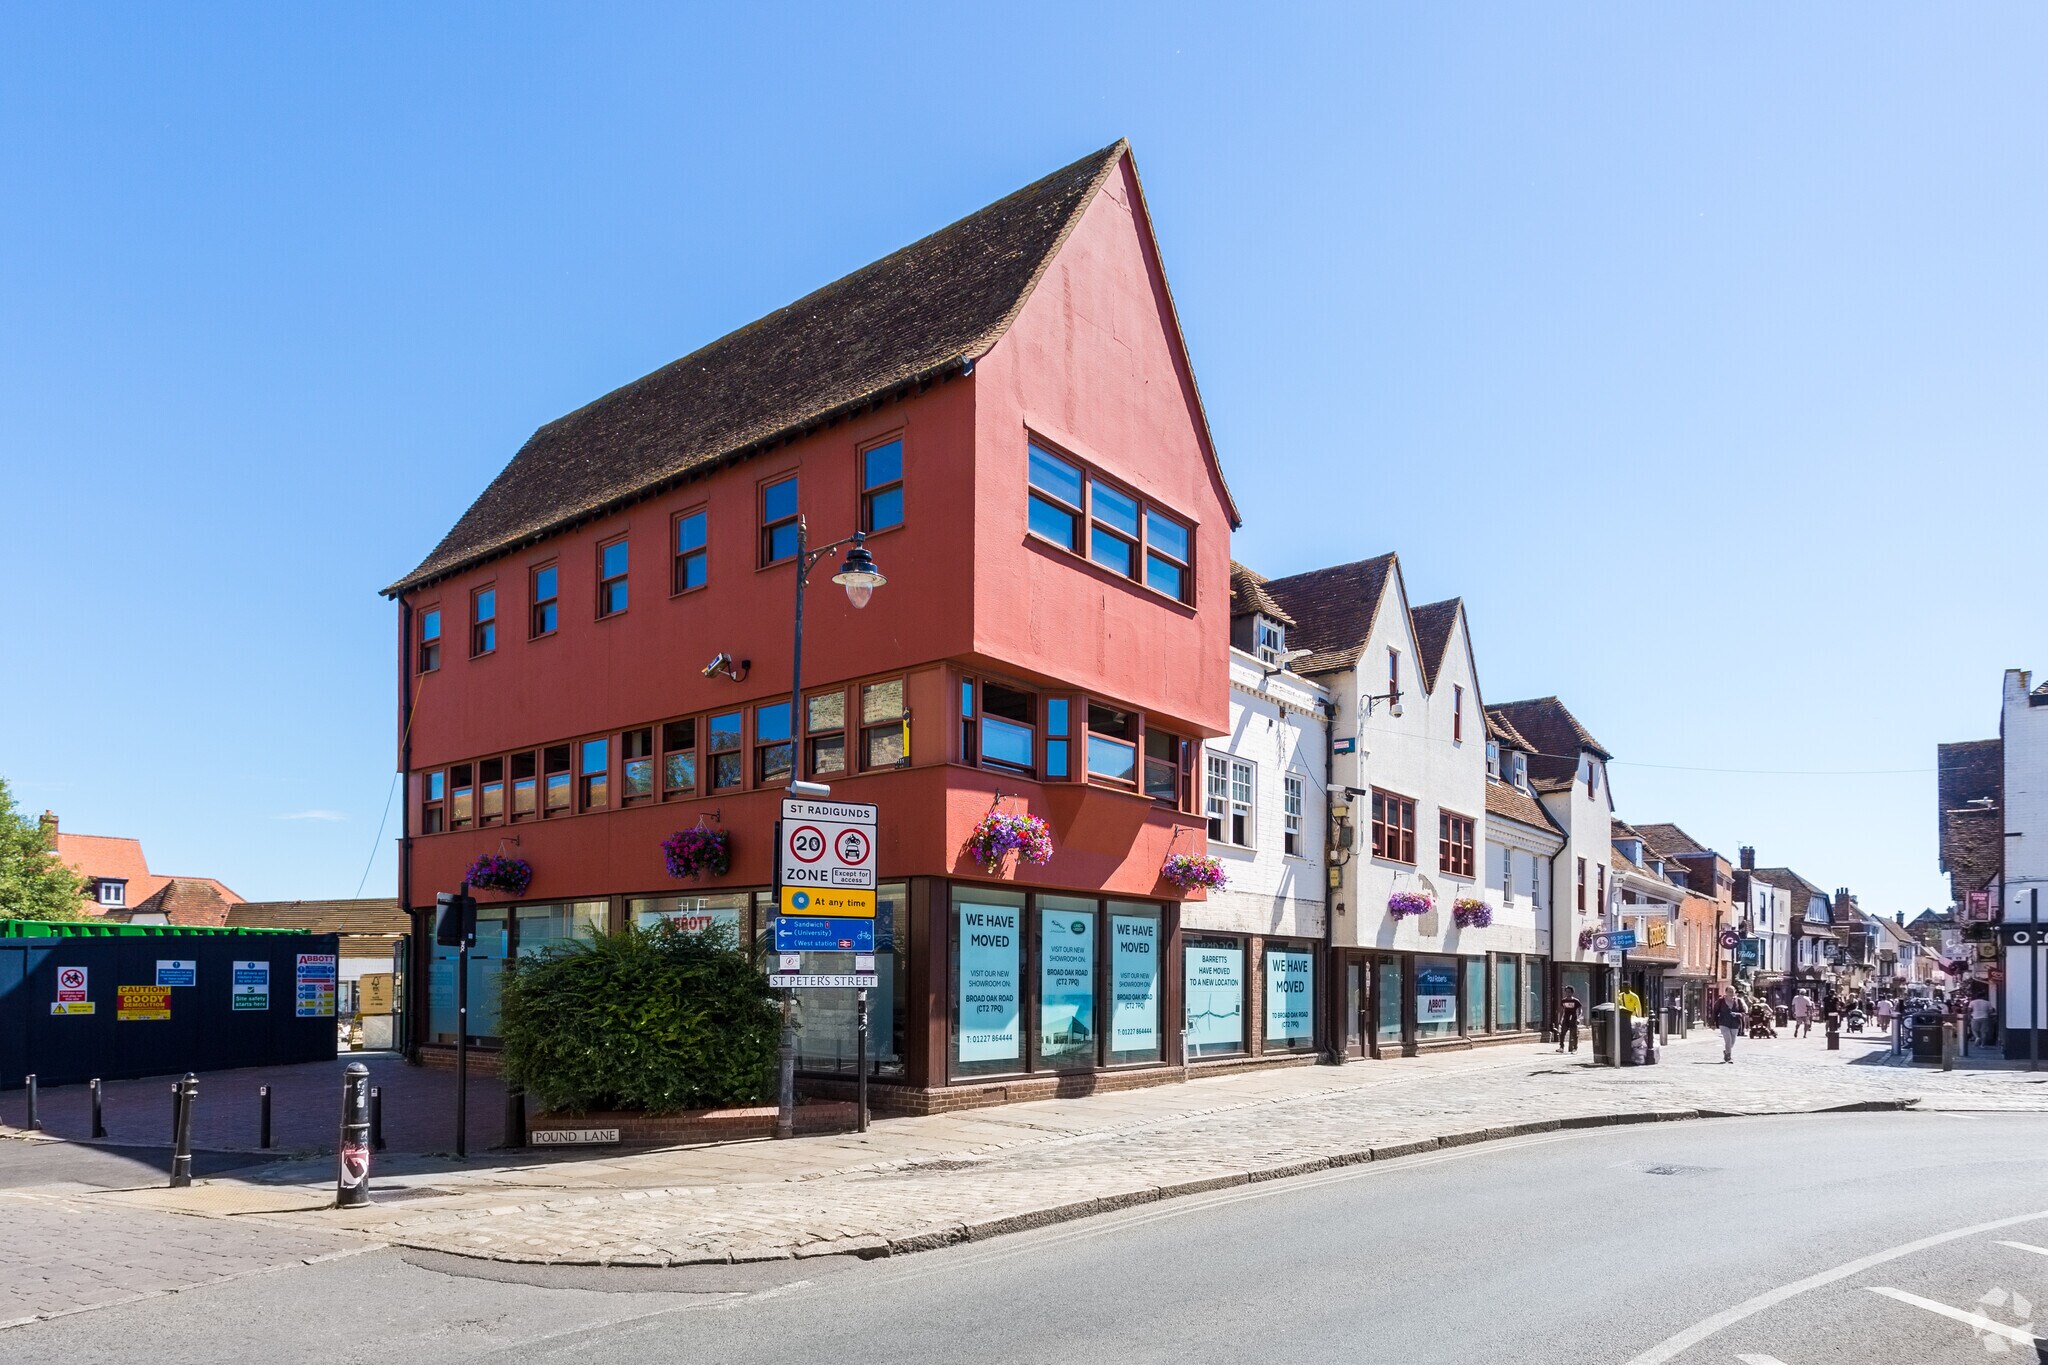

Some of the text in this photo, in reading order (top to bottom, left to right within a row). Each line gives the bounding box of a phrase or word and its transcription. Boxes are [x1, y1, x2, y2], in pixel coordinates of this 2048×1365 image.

[790, 804, 870, 818] ST RADIGUNDS
[796, 836, 820, 852] 20
[786, 868, 828, 882] ZONE
[834, 870, 856, 878] Except
[966, 913, 1014, 928] WE HAVE
[1117, 924, 1153, 936] WE HAVE
[971, 934, 1010, 948] MOVED
[1120, 942, 1150, 953] MOVED
[298, 956, 334, 964] ABBOTT
[1202, 955, 1227, 963] BARRETTS
[1738, 951, 1756, 959] Tulip
[1272, 960, 1308, 972] WE HAVE
[772, 975, 875, 986] ST PETER'S STREET
[1056, 979, 1068, 987] (CT2
[1276, 981, 1304, 993] MOVED
[977, 1005, 1004, 1014] (CT2 7PQ)
[536, 1130, 616, 1142] POUND LANE
